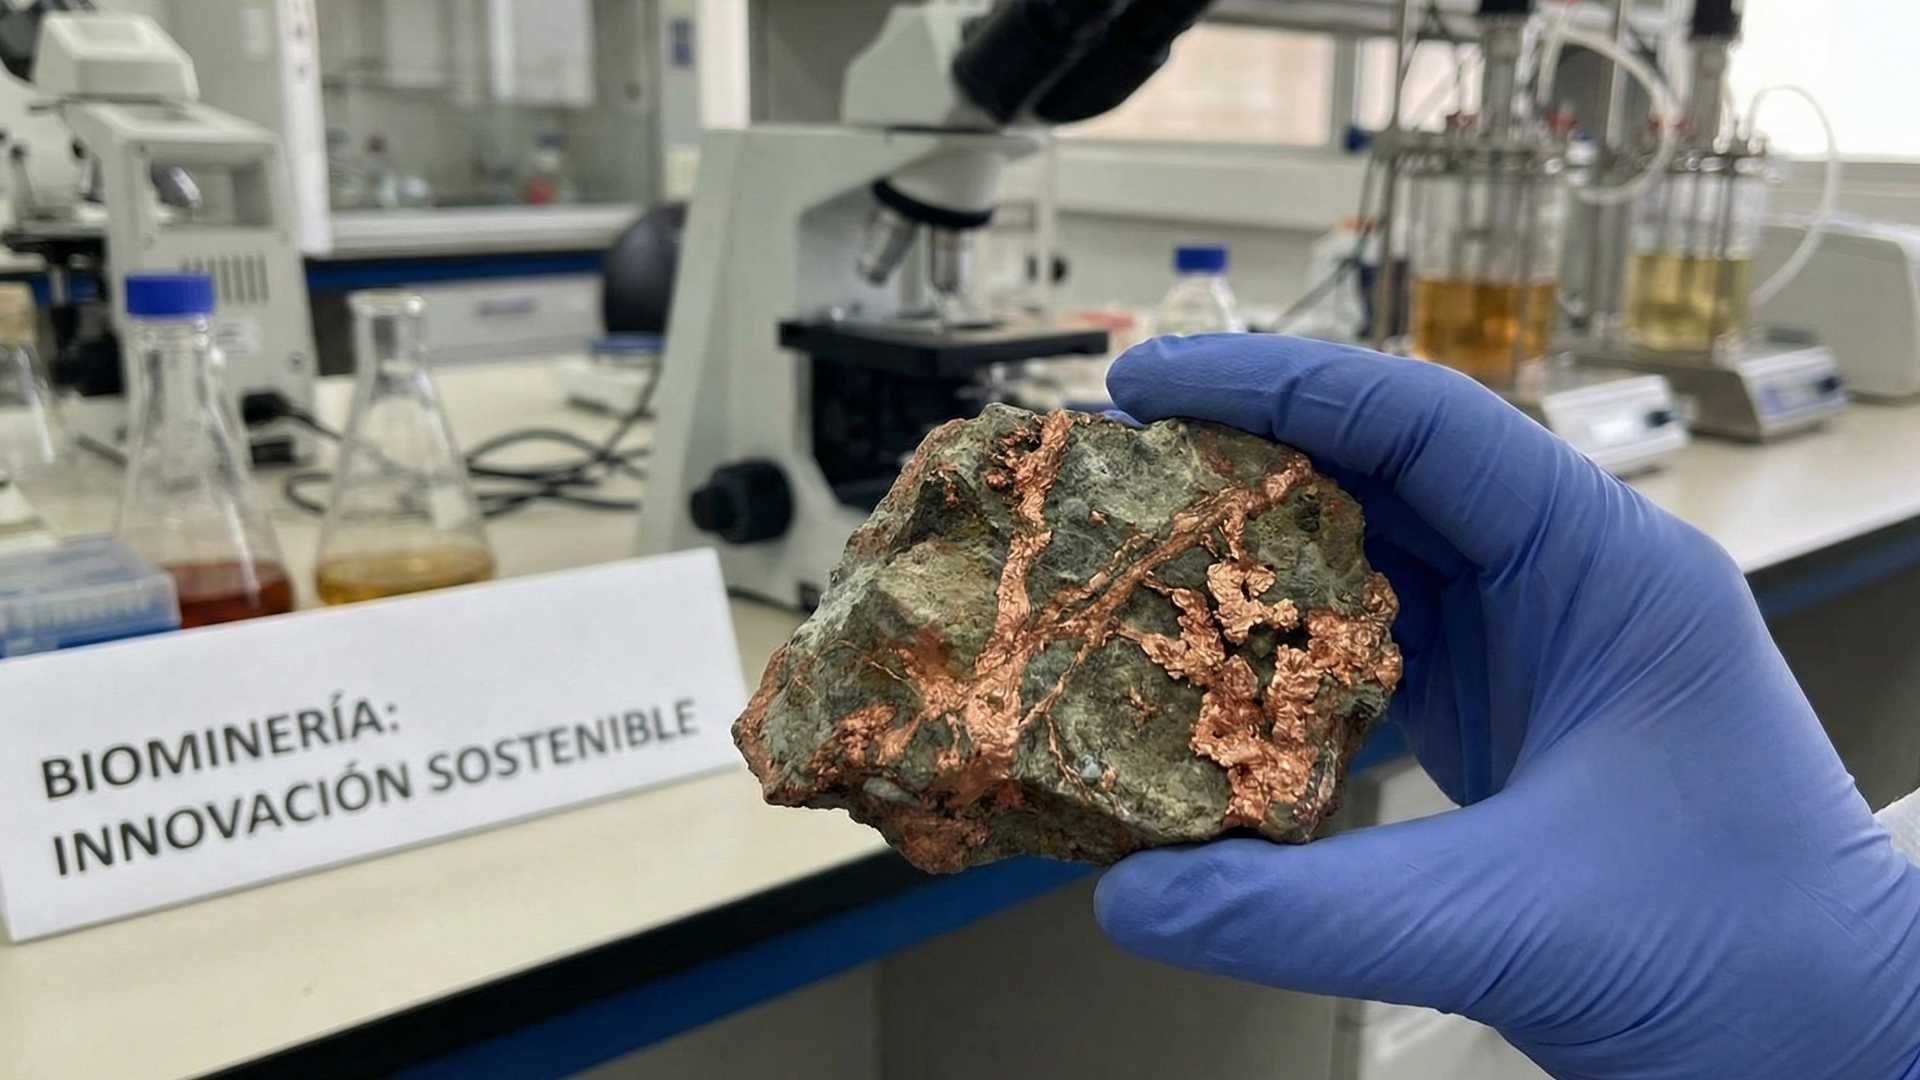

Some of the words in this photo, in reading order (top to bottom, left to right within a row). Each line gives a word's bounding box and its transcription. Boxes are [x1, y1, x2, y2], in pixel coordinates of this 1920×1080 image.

[41, 690, 399, 800] BIOMINERÍA:
[53, 758, 412, 876] INNOVACIÓN
[427, 698, 698, 792] SOSTENIBLE
